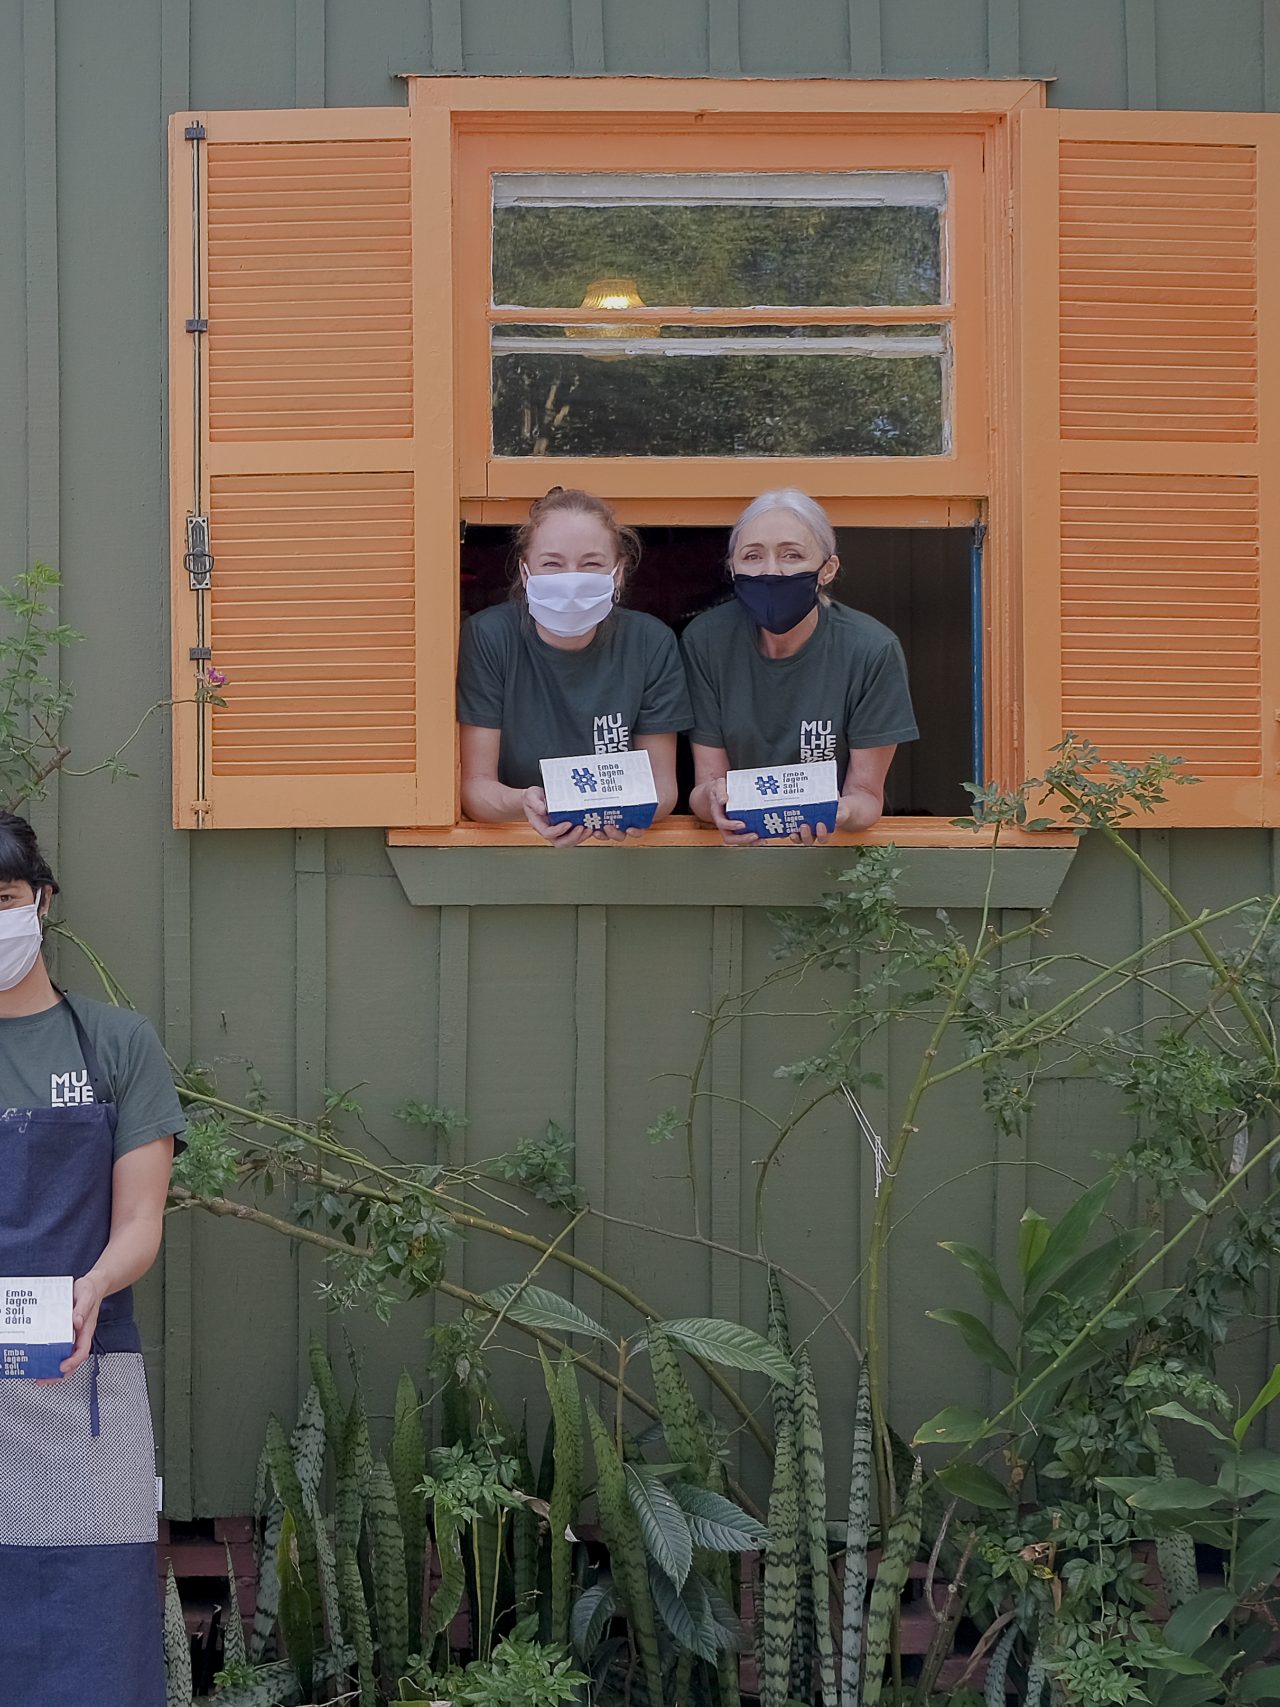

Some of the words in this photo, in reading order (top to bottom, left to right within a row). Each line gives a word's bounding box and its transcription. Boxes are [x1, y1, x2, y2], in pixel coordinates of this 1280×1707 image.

[594, 713, 622, 730] MU
[801, 720, 832, 735] MU
[594, 727, 629, 745] LHE
[801, 735, 837, 749] LHE
[595, 741, 629, 755] RES
[801, 748, 835, 760] RES
[51, 1069, 88, 1088] MU
[51, 1085, 94, 1103] LHE
[5, 1289, 33, 1298] Emba
[5, 1297, 38, 1308] lagem
